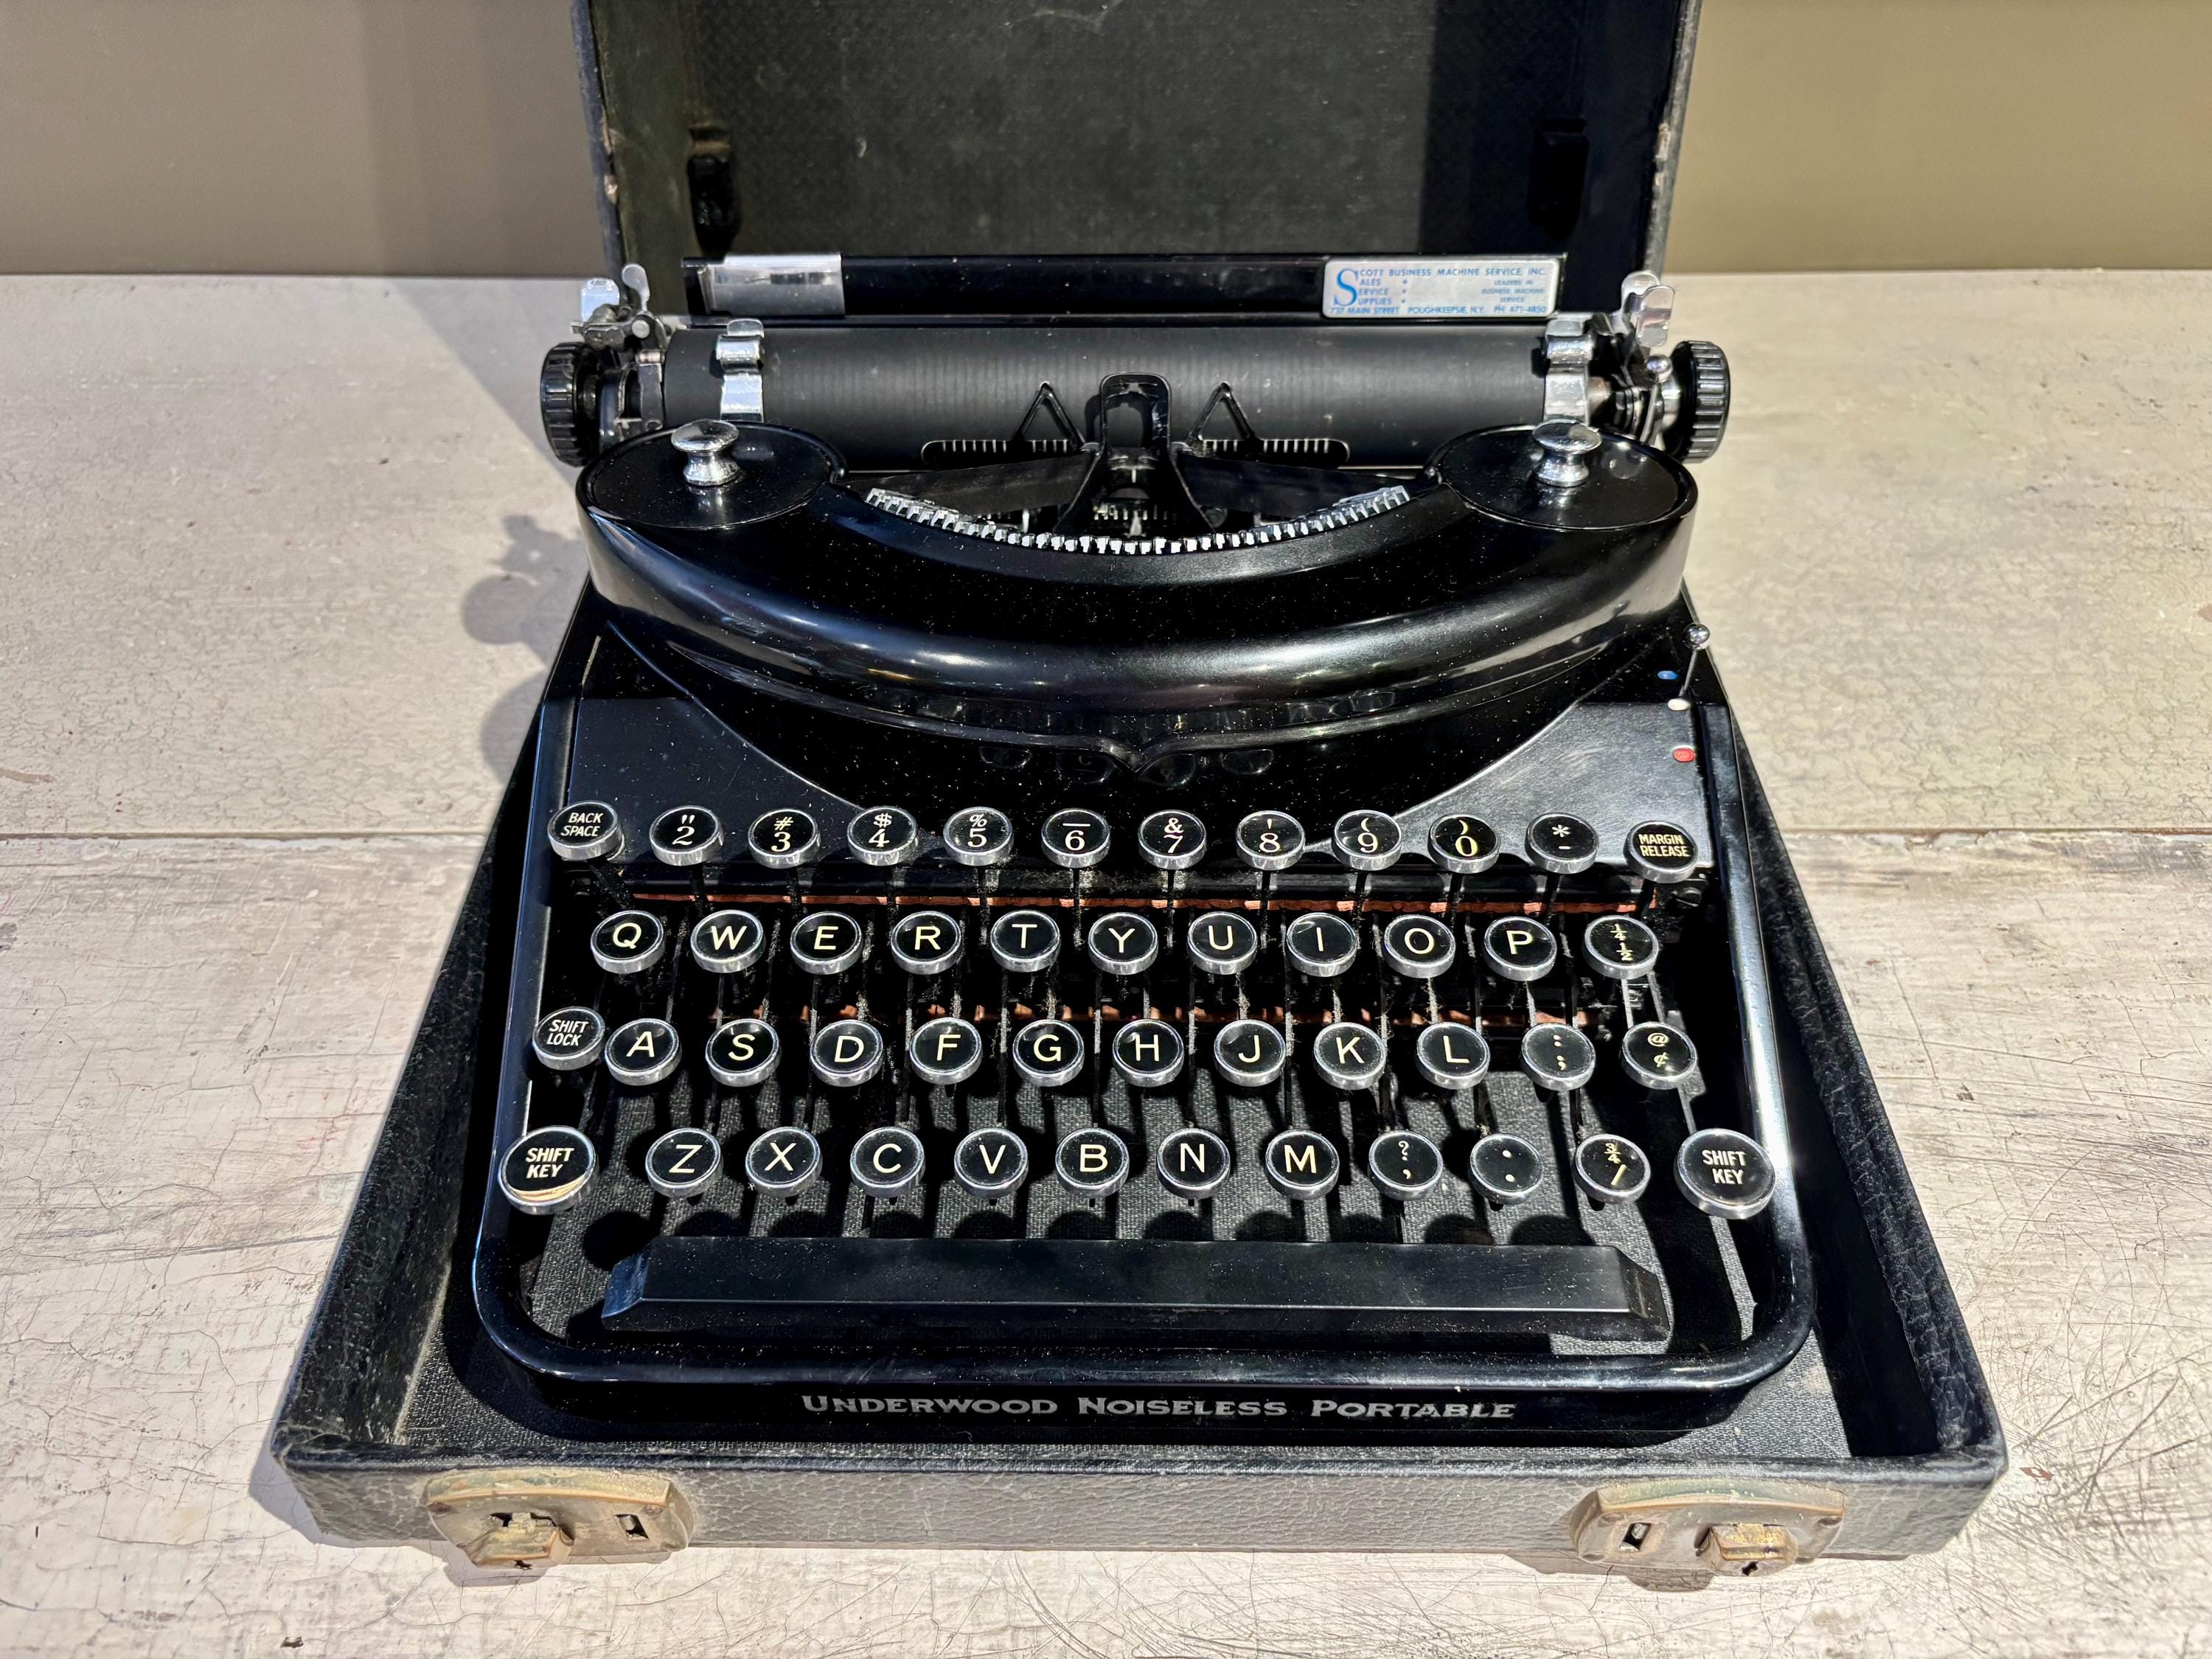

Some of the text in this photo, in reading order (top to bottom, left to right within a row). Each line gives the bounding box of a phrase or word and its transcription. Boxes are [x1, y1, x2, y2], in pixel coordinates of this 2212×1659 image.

[568, 813, 603, 823] BACK
[874, 813, 892, 827] $
[968, 813, 987, 827] %
[1164, 818, 1183, 833] &
[561, 826, 599, 838] SPACE
[672, 827, 694, 845] 2
[771, 832, 790, 852] 3
[869, 829, 889, 846] 4
[967, 828, 987, 847] 5
[1065, 830, 1085, 850] 6
[1259, 833, 1281, 852] 8
[1356, 832, 1378, 854] 9
[1638, 832, 1684, 844] MARGIN
[1164, 835, 1183, 853] 7
[1638, 844, 1690, 858] RELEASE
[613, 923, 641, 949] Q
[710, 926, 747, 950] W
[813, 926, 838, 950] E
[915, 926, 940, 950] R
[1012, 924, 1037, 948] T
[1109, 928, 1135, 953] Y
[1208, 925, 1233, 950] U
[1317, 928, 1324, 951] I
[1405, 928, 1433, 954] O
[1506, 931, 1532, 954] P
[549, 1018, 588, 1034] SHIFT
[546, 1032, 582, 1046] LOCK
[627, 1032, 654, 1057] A
[728, 1034, 755, 1060] S
[835, 1036, 863, 1062] D
[937, 1034, 961, 1060] F
[1034, 1034, 1061, 1061] G
[1135, 1034, 1159, 1061] H
[1237, 1035, 1259, 1062] J
[1336, 1037, 1365, 1063] K
[1444, 1036, 1470, 1063] L
[1648, 1033, 1669, 1046] @
[526, 1148, 574, 1162] SHIFT
[669, 1144, 702, 1173] Z
[765, 1143, 796, 1171] X
[874, 1144, 902, 1173] C
[979, 1145, 1006, 1174] V
[1080, 1144, 1107, 1172] B
[1180, 1144, 1204, 1172] N
[1284, 1145, 1316, 1173] M
[1703, 1150, 1745, 1166] SHIFT
[526, 1164, 563, 1178] KEY
[1712, 1169, 1743, 1184] KEY
[803, 1397, 1514, 1417] UNDERWOOD NOISELESS PORTABLE
